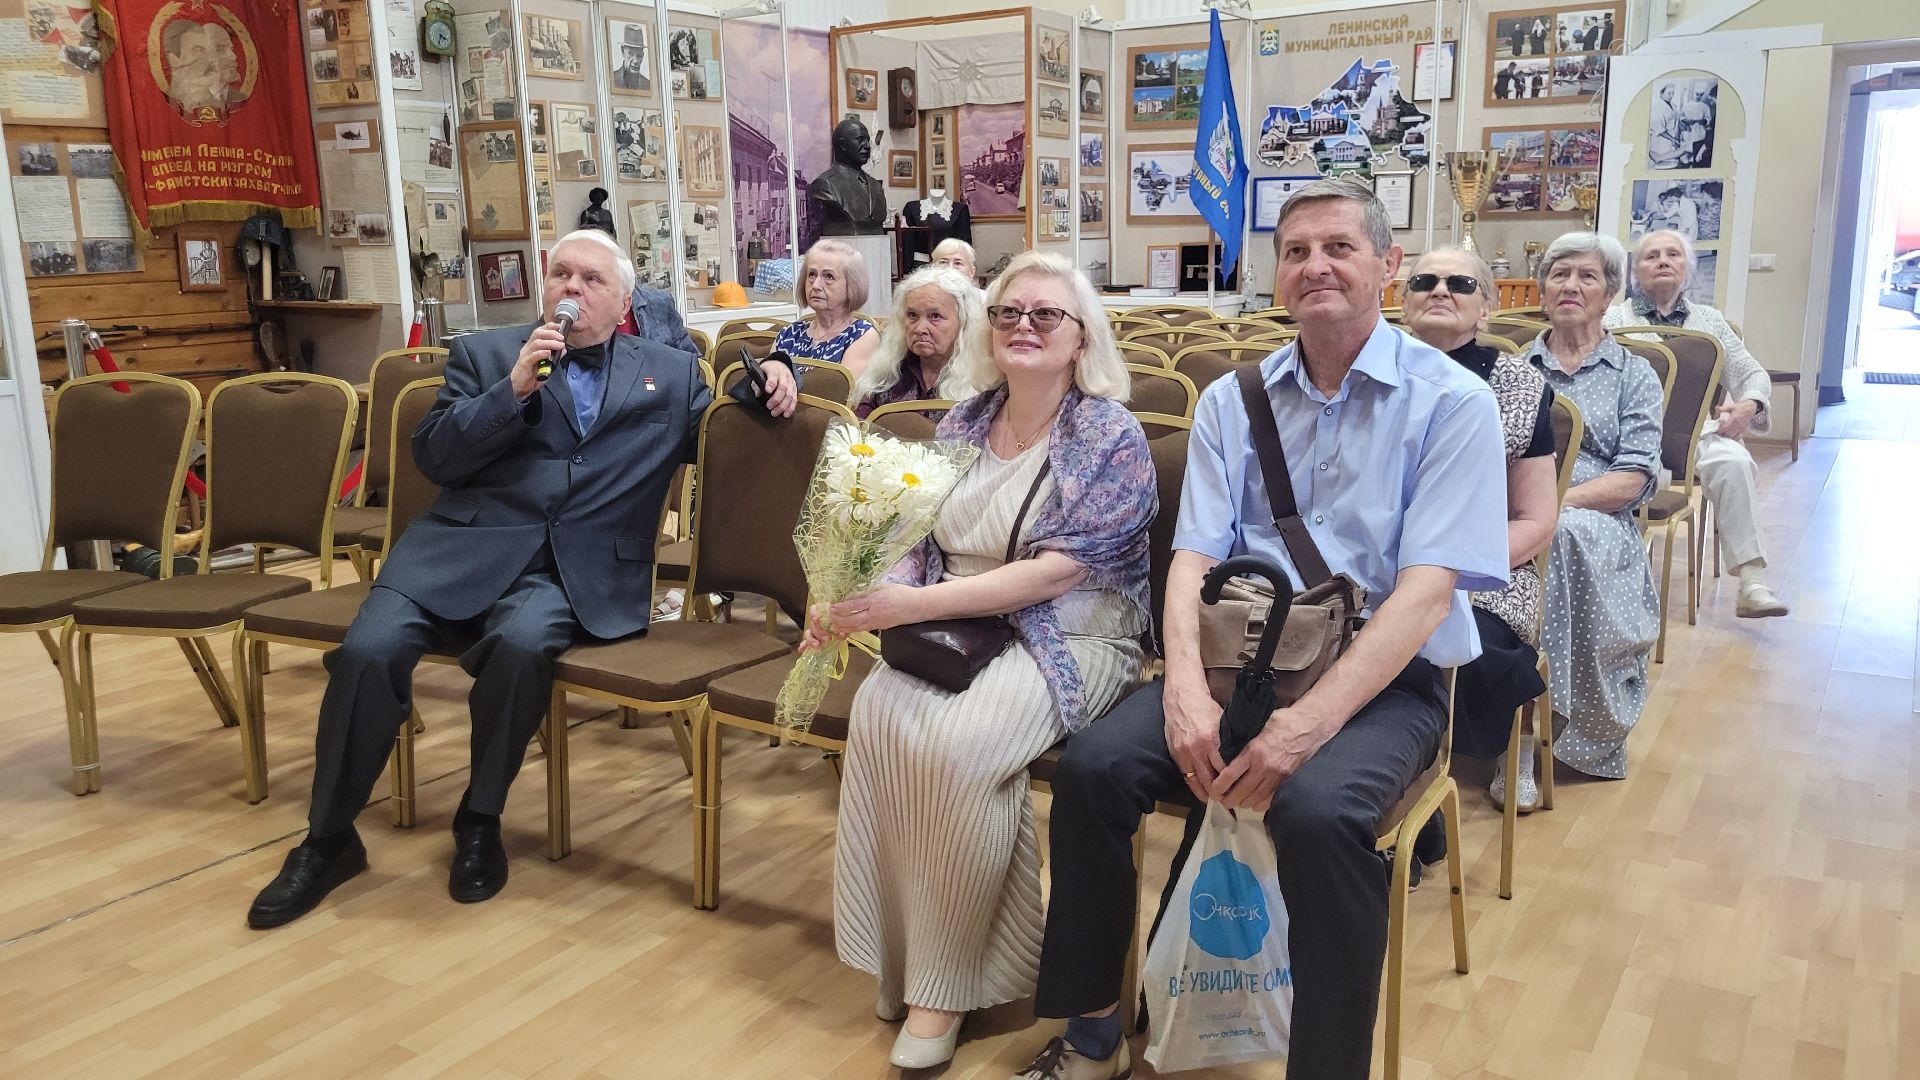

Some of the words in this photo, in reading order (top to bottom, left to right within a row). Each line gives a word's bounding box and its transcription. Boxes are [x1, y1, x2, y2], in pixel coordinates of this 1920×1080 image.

[1328, 14, 1409, 36] ЛЕНИНСКИЙ
[1284, 29, 1404, 54] МУНИЦИПАЛЬНЫЙ
[1407, 26, 1453, 42] РАЙН
[198, 160, 217, 172] НА
[1189, 968, 1259, 995] УВИДИТЕ
[1263, 966, 1292, 993] САМ
